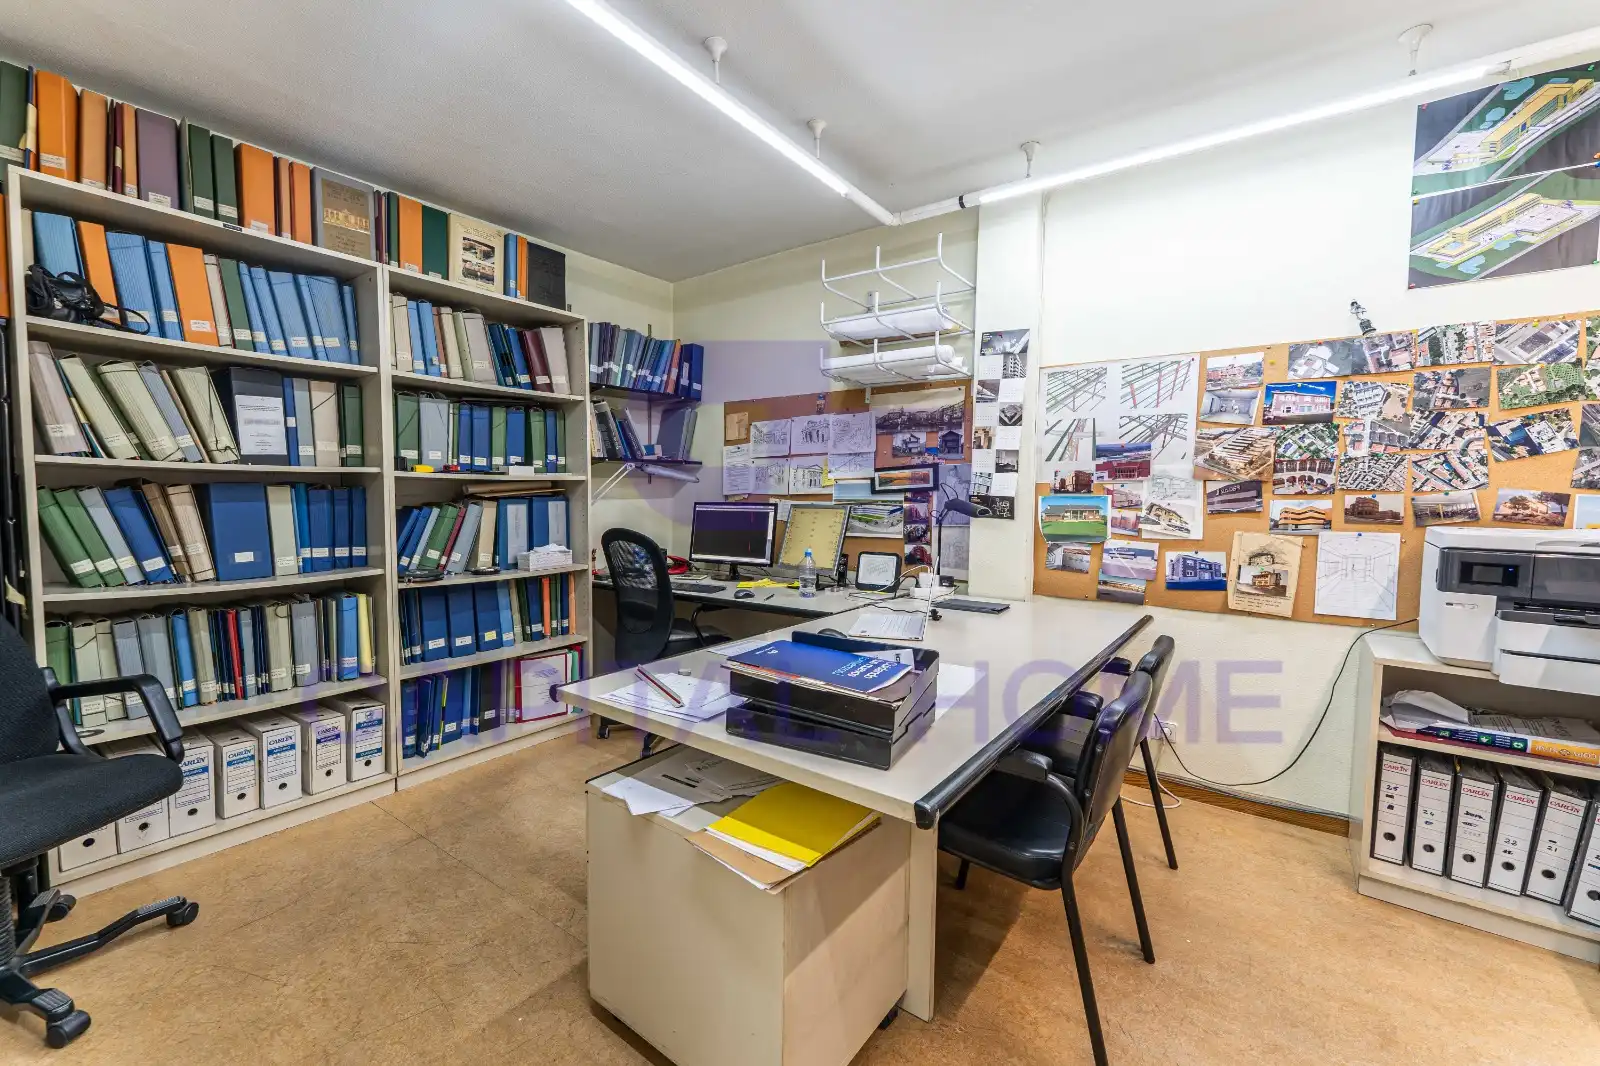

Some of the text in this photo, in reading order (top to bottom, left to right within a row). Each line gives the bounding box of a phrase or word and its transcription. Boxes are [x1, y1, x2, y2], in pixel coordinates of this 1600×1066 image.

[180, 756, 206, 767] ARLIN
[1383, 763, 1409, 773] CARLIN
[1421, 778, 1449, 788] CARLIN
[1462, 787, 1490, 798] CARLIN
[1506, 794, 1536, 805] CARLIN
[1549, 801, 1581, 814] CARLIN
